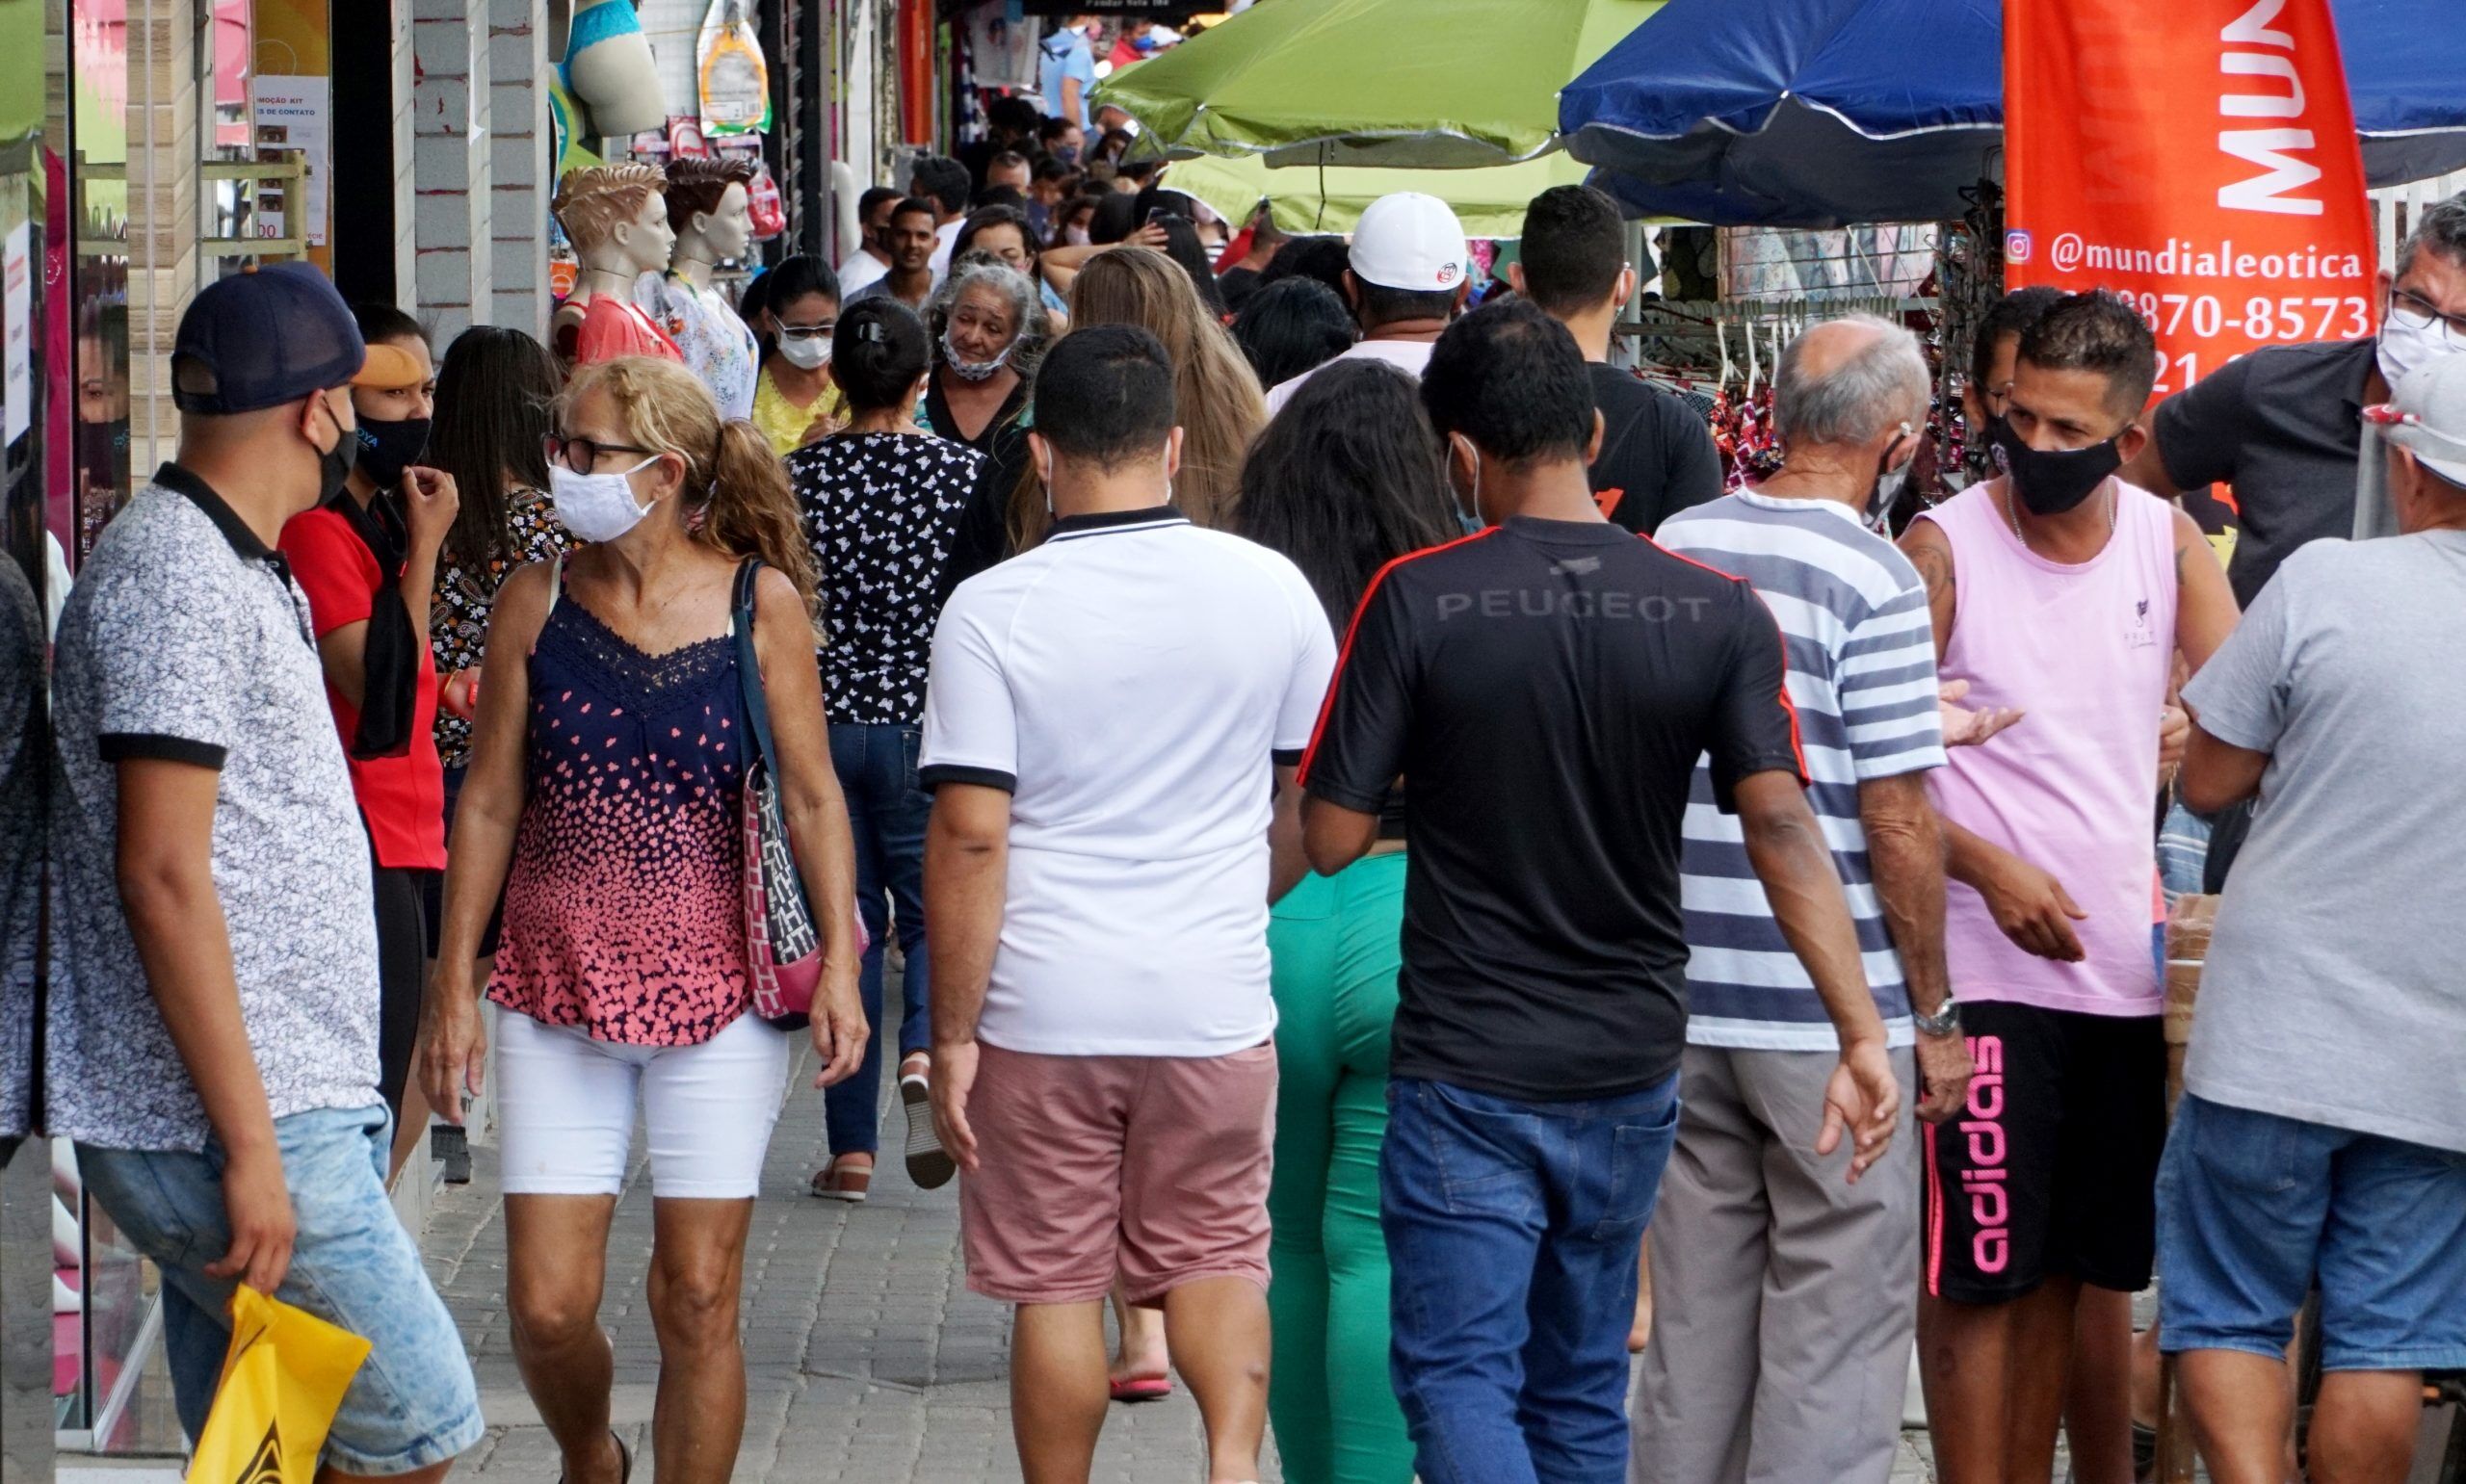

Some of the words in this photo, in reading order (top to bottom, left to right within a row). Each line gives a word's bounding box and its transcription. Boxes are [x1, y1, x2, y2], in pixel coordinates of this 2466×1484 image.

[308, 231, 324, 240] ÉCIE
[2051, 233, 2363, 279] @mundialeotica
[2098, 286, 2369, 340] 870-8573
[355, 428, 378, 448] OYA
[1436, 589, 1711, 623] PEUGEOT
[1958, 1034, 2009, 1274] adidas
